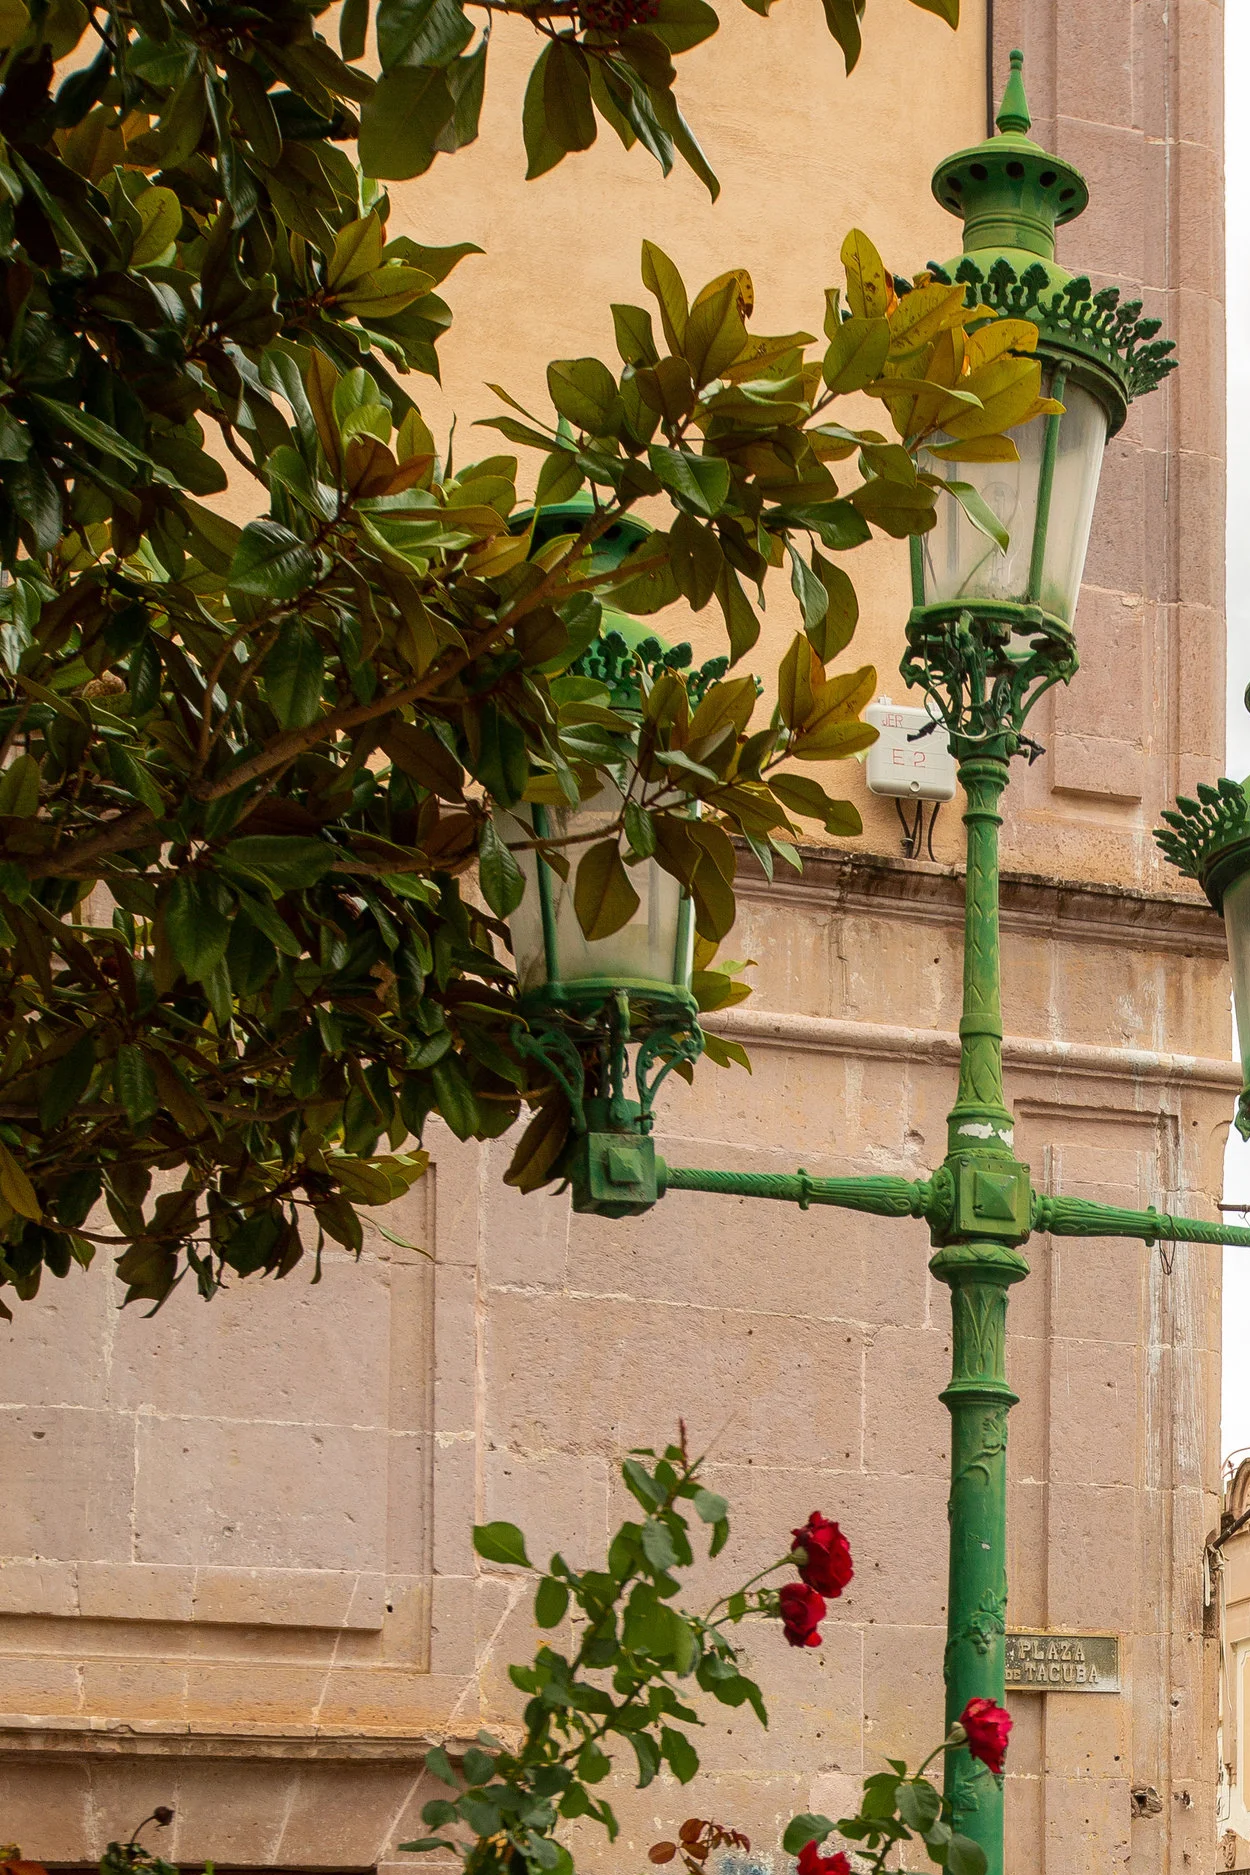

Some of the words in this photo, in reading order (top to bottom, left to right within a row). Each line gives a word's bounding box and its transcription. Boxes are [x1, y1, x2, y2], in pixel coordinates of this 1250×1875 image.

[892, 748, 904, 766] E
[913, 751, 926, 768] 2
[1018, 1639, 1086, 1661] PLAZA
[1005, 1668, 1021, 1681] DE
[1024, 1661, 1099, 1683] TACUBA
